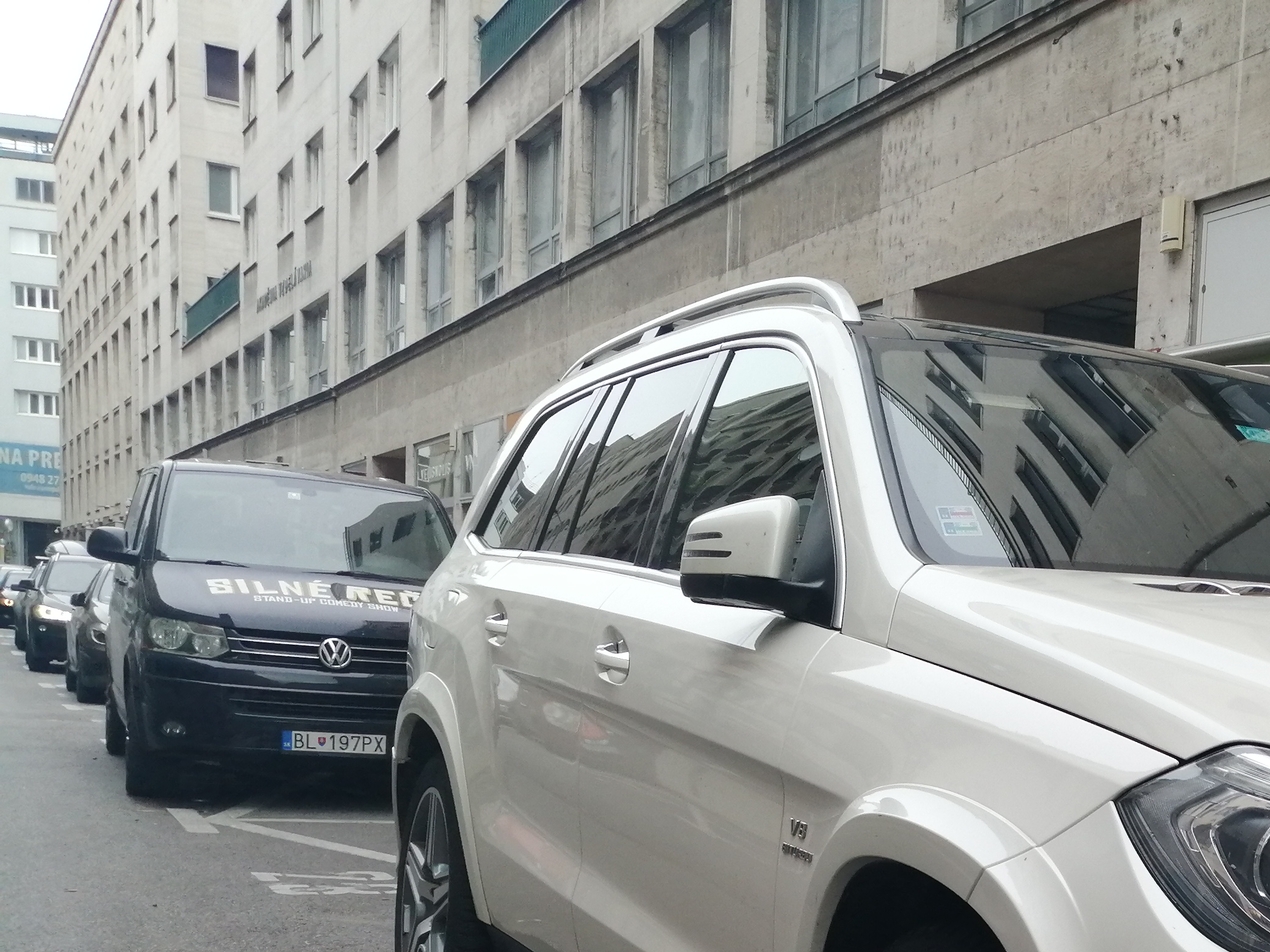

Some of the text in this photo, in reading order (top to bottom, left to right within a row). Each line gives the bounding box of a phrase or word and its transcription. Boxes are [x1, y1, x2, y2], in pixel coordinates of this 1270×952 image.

[206, 579, 332, 598] SILNÉ
[253, 595, 399, 612] STAND-UP COMEDY SHOW
[294, 733, 316, 749] BL
[330, 734, 384, 752] 197PX
